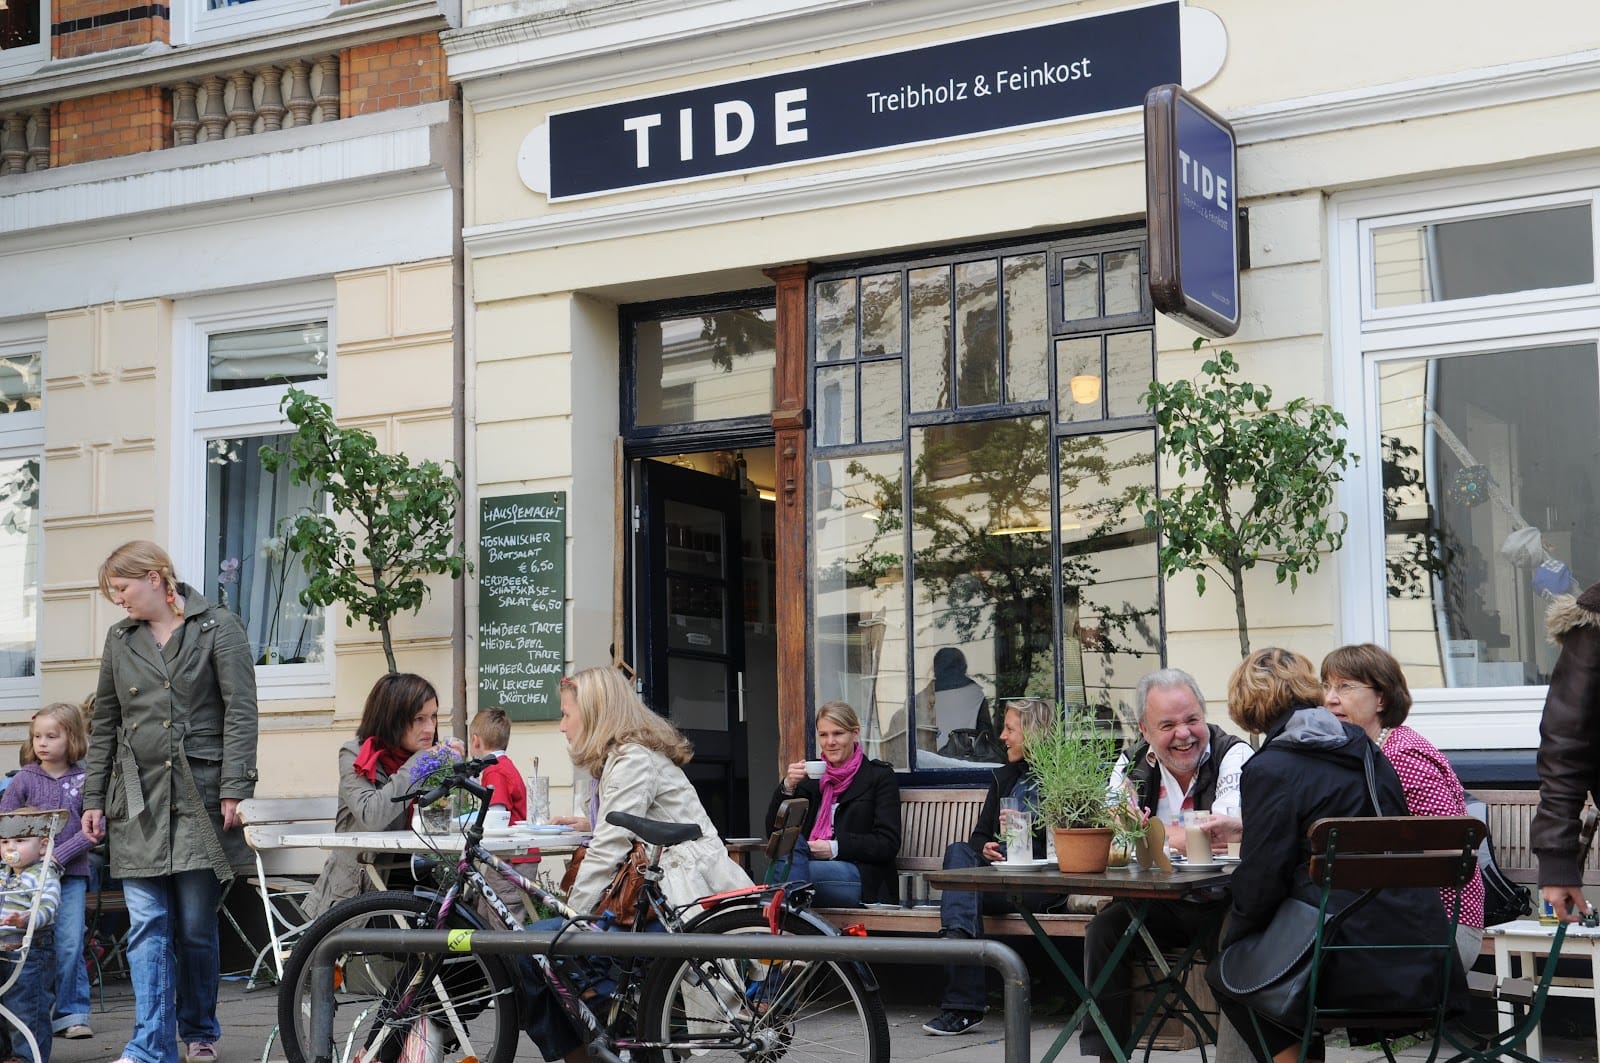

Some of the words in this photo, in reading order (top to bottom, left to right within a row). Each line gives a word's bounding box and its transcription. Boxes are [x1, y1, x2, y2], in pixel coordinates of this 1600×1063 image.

[867, 79, 968, 113] Treibholz
[974, 75, 992, 97] &
[996, 57, 1092, 93] Feinkost
[623, 87, 809, 169] TIDE
[1179, 149, 1228, 211] TIDE
[484, 504, 564, 524] HAUSGEMACHT
[530, 560, 554, 573] 6,50
[498, 596, 531, 607] SALAT
[529, 622, 563, 634] TARTE
[528, 650, 560, 660] TARTE
[525, 664, 561, 674] QUARK
[503, 679, 544, 690] LECKERE
